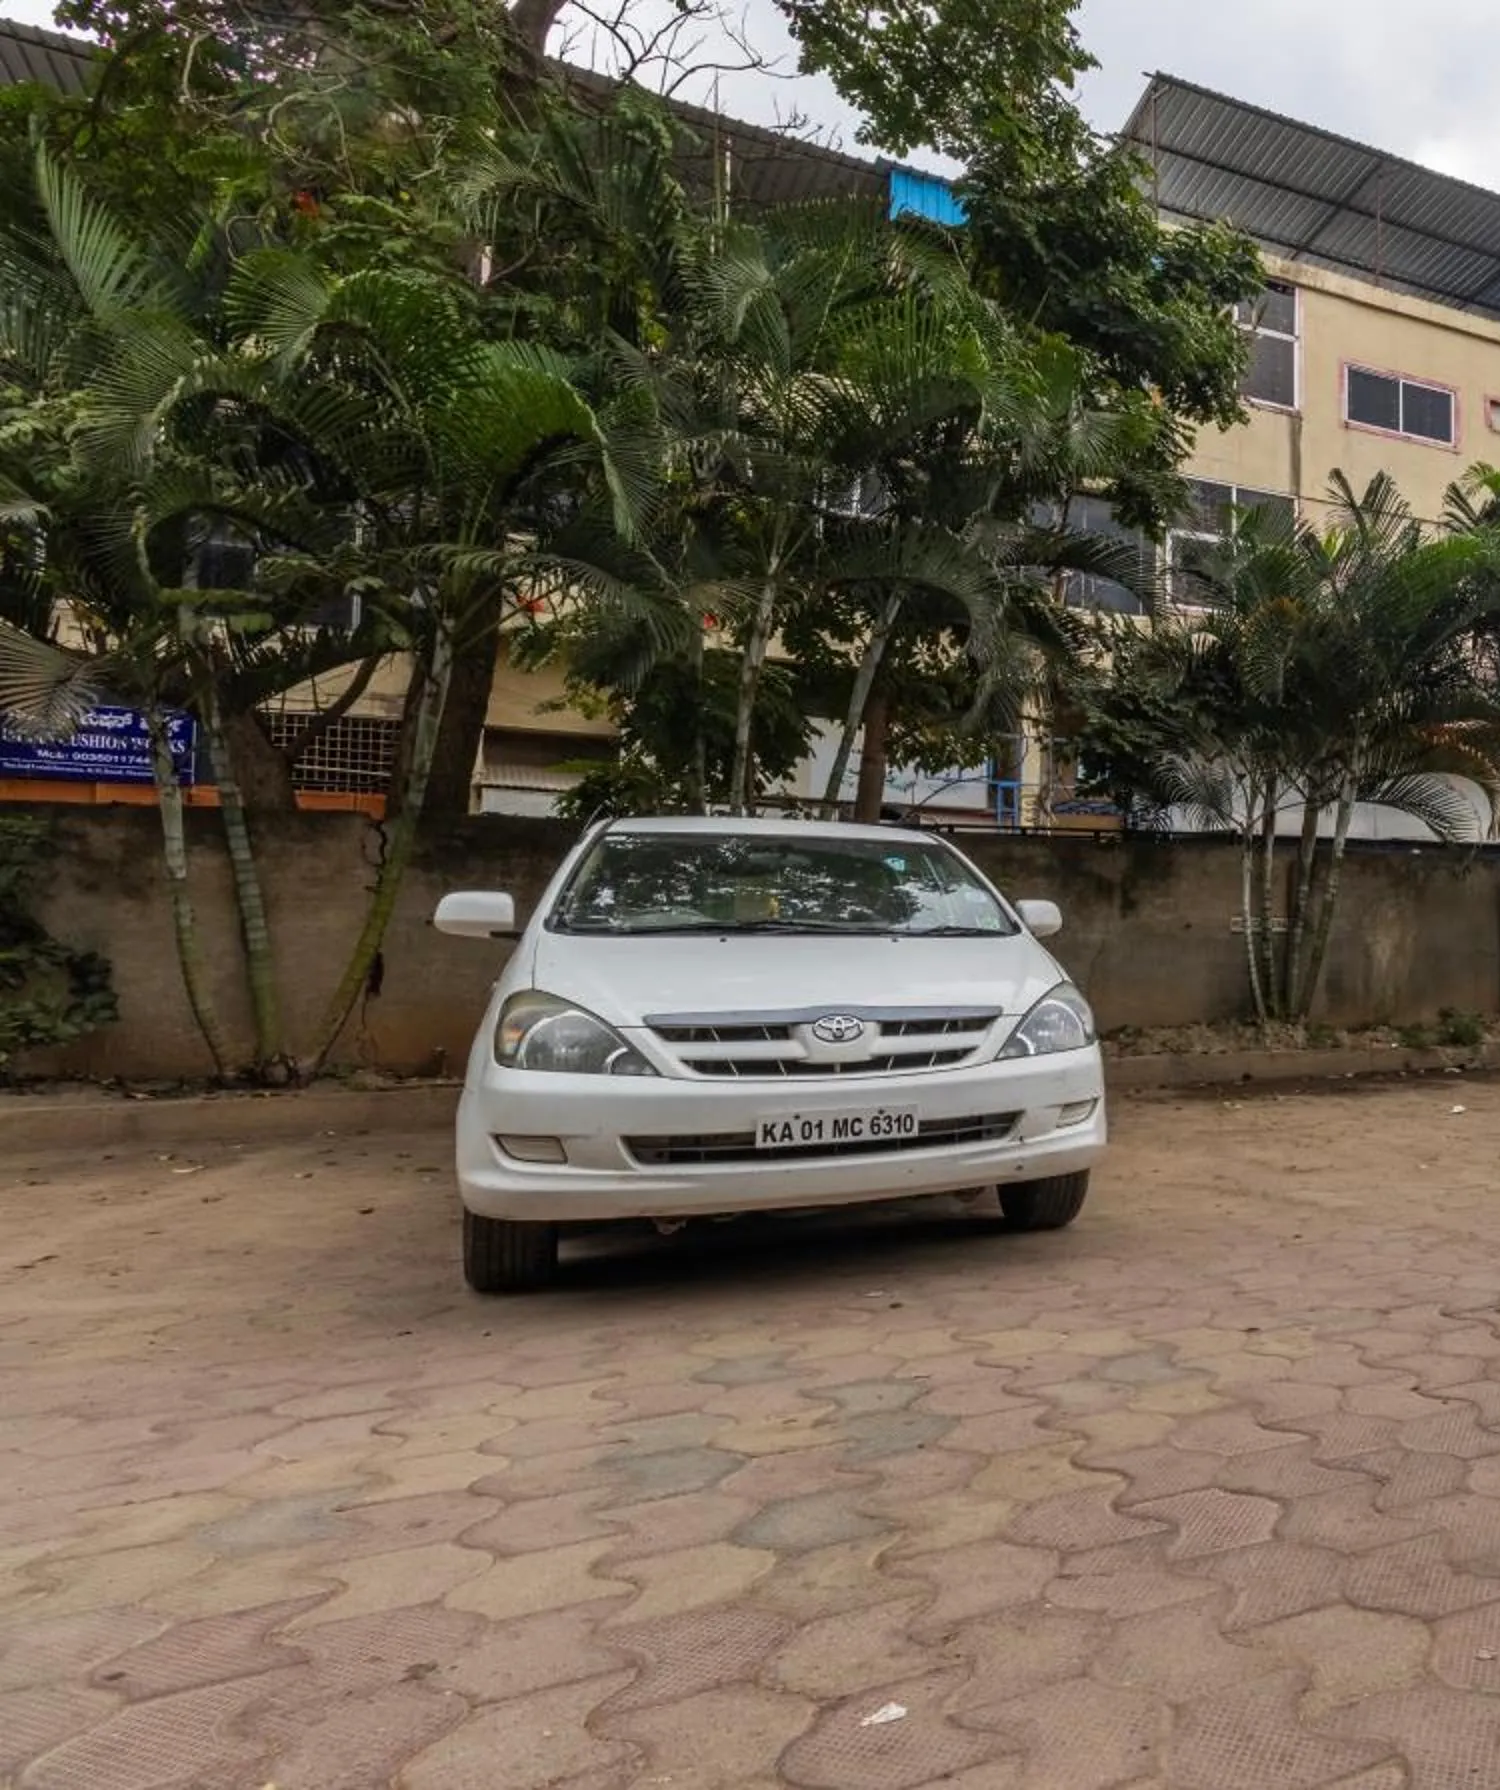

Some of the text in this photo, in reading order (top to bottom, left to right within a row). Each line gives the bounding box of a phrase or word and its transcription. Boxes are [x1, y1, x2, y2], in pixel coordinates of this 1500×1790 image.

[62, 733, 127, 751] USHION
[762, 1113, 914, 1143] KA 01 MC 6310
